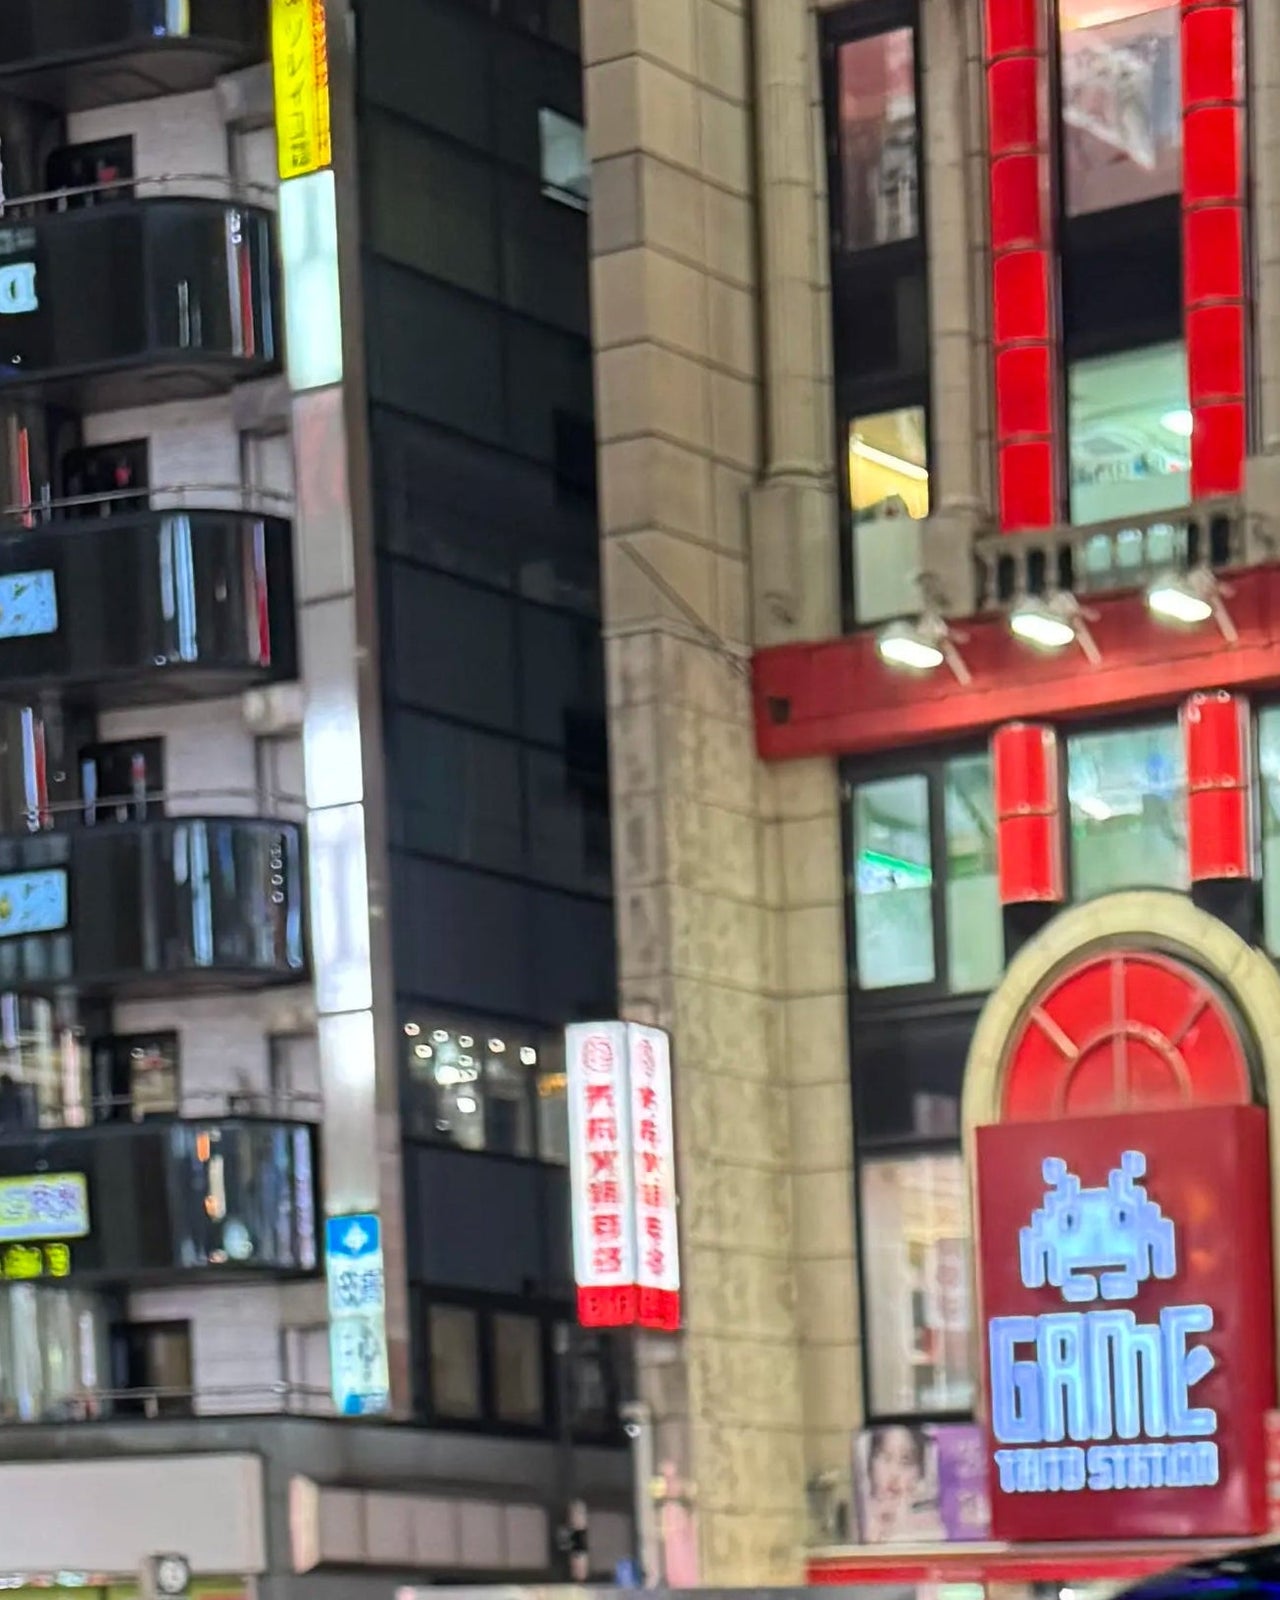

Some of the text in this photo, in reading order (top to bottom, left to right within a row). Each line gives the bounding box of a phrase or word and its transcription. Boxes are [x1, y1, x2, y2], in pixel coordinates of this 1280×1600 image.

[988, 1303, 1218, 1444] GAME
[993, 1446, 1086, 1494] TAITO
[1086, 1441, 1220, 1491] STATION
